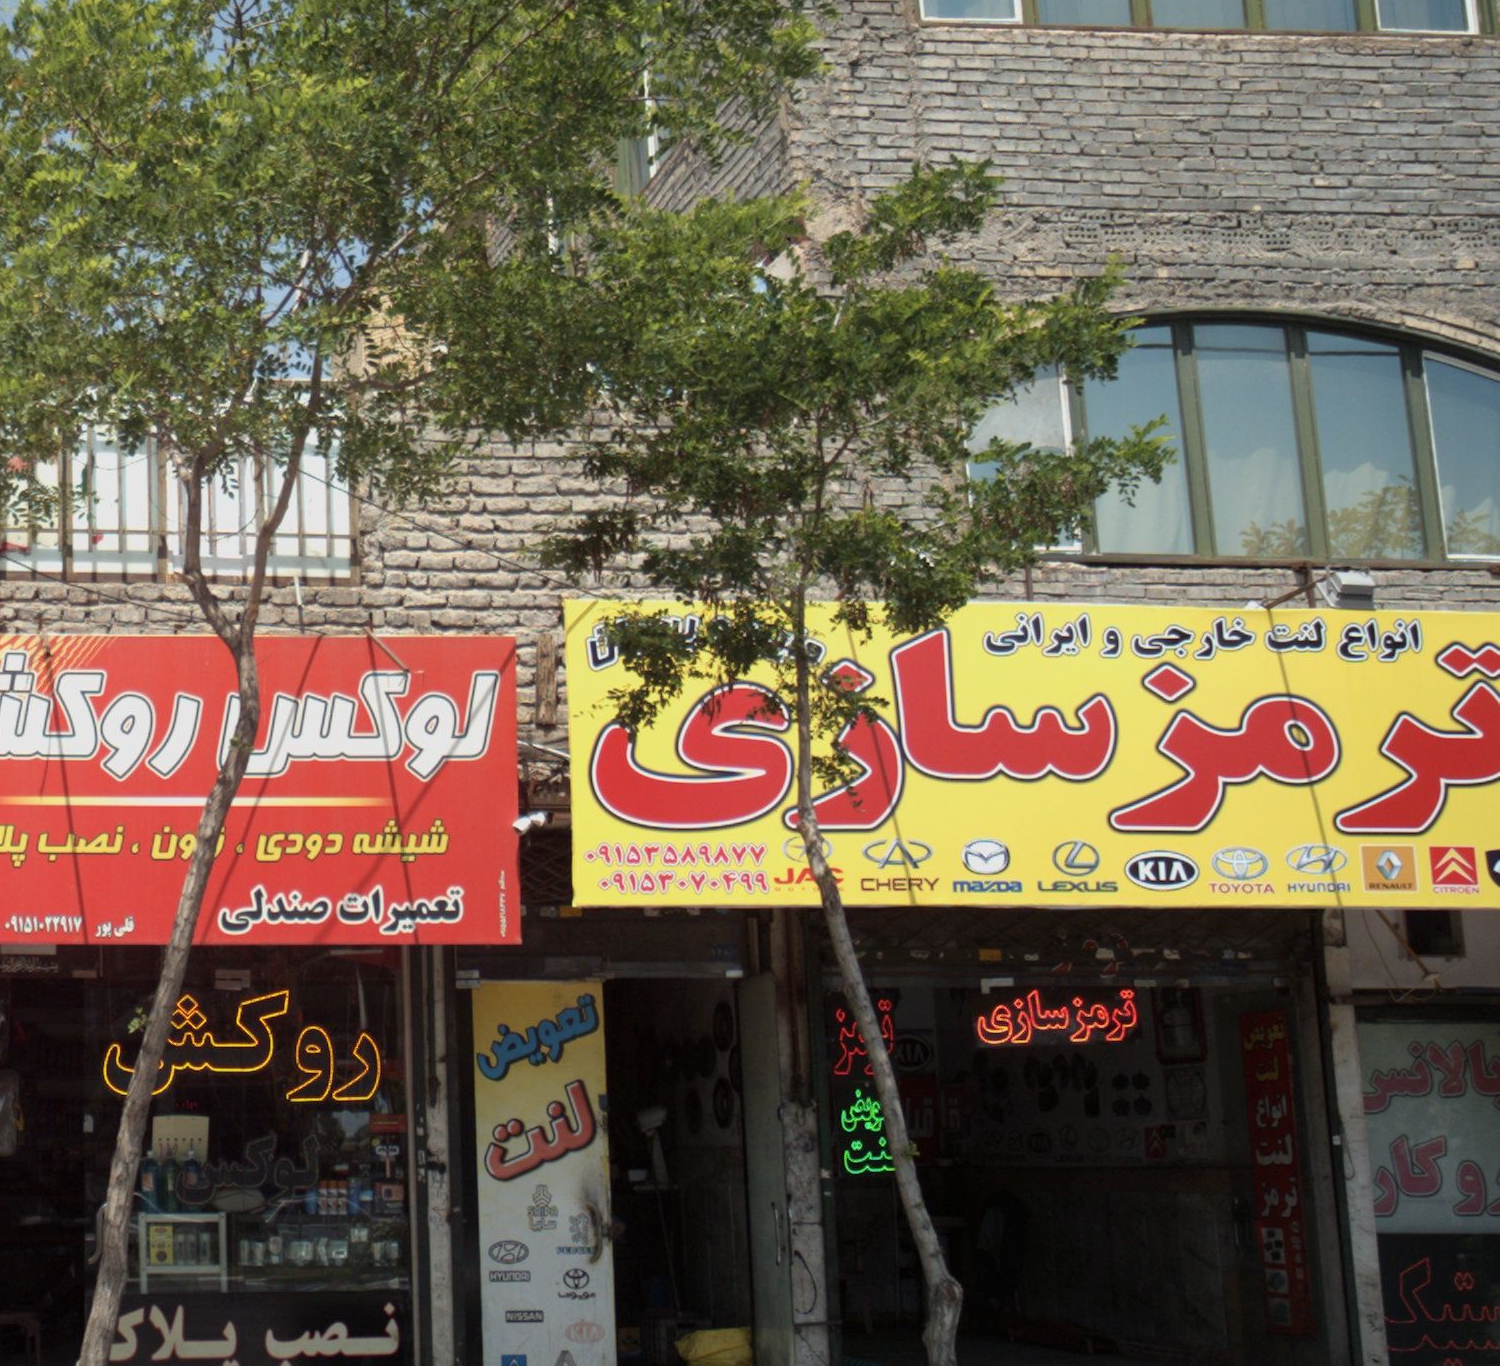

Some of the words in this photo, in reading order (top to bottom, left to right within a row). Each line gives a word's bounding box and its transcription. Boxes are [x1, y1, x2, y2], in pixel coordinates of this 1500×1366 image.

[984, 611, 1091, 656] ایرانی
[1101, 626, 1122, 658] و
[1131, 618, 1254, 660] خارجی
[1265, 617, 1326, 651] لنت
[1337, 618, 1422, 662] انواع
[216, 671, 501, 781] لوکس
[590, 628, 1118, 832] سازی
[1108, 641, 1500, 834] ترمز
[37, 825, 124, 862] نصب
[255, 824, 342, 862] دودی
[352, 819, 450, 859] شیشه
[585, 842, 767, 867] ۰۹۱۵۳۵۸۹۸۷۷
[598, 870, 770, 895] ۰۹۱۵۳۰۷۰۴۹۹
[861, 878, 940, 891] CHERY
[1037, 881, 1118, 892] LEXUS
[1138, 861, 1188, 881] KIA
[1209, 883, 1275, 894] TOYOTA
[1288, 883, 1350, 893] HYUNDAI
[1368, 882, 1414, 890] RENAULT
[218, 887, 329, 934] صندلی
[338, 885, 464, 934] تعمیرات
[977, 989, 1069, 1045] سازی
[1071, 989, 1138, 1042] ترمز
[1244, 1014, 1286, 1054] تعویض
[102, 989, 381, 1103] روکش
[476, 993, 599, 1081] تعویض
[484, 1078, 598, 1182] لنت
[1255, 1094, 1288, 1128] انواع
[1255, 1136, 1294, 1167] لنت
[1261, 1176, 1299, 1219] ترمز
[505, 1311, 544, 1323] NISSAN
